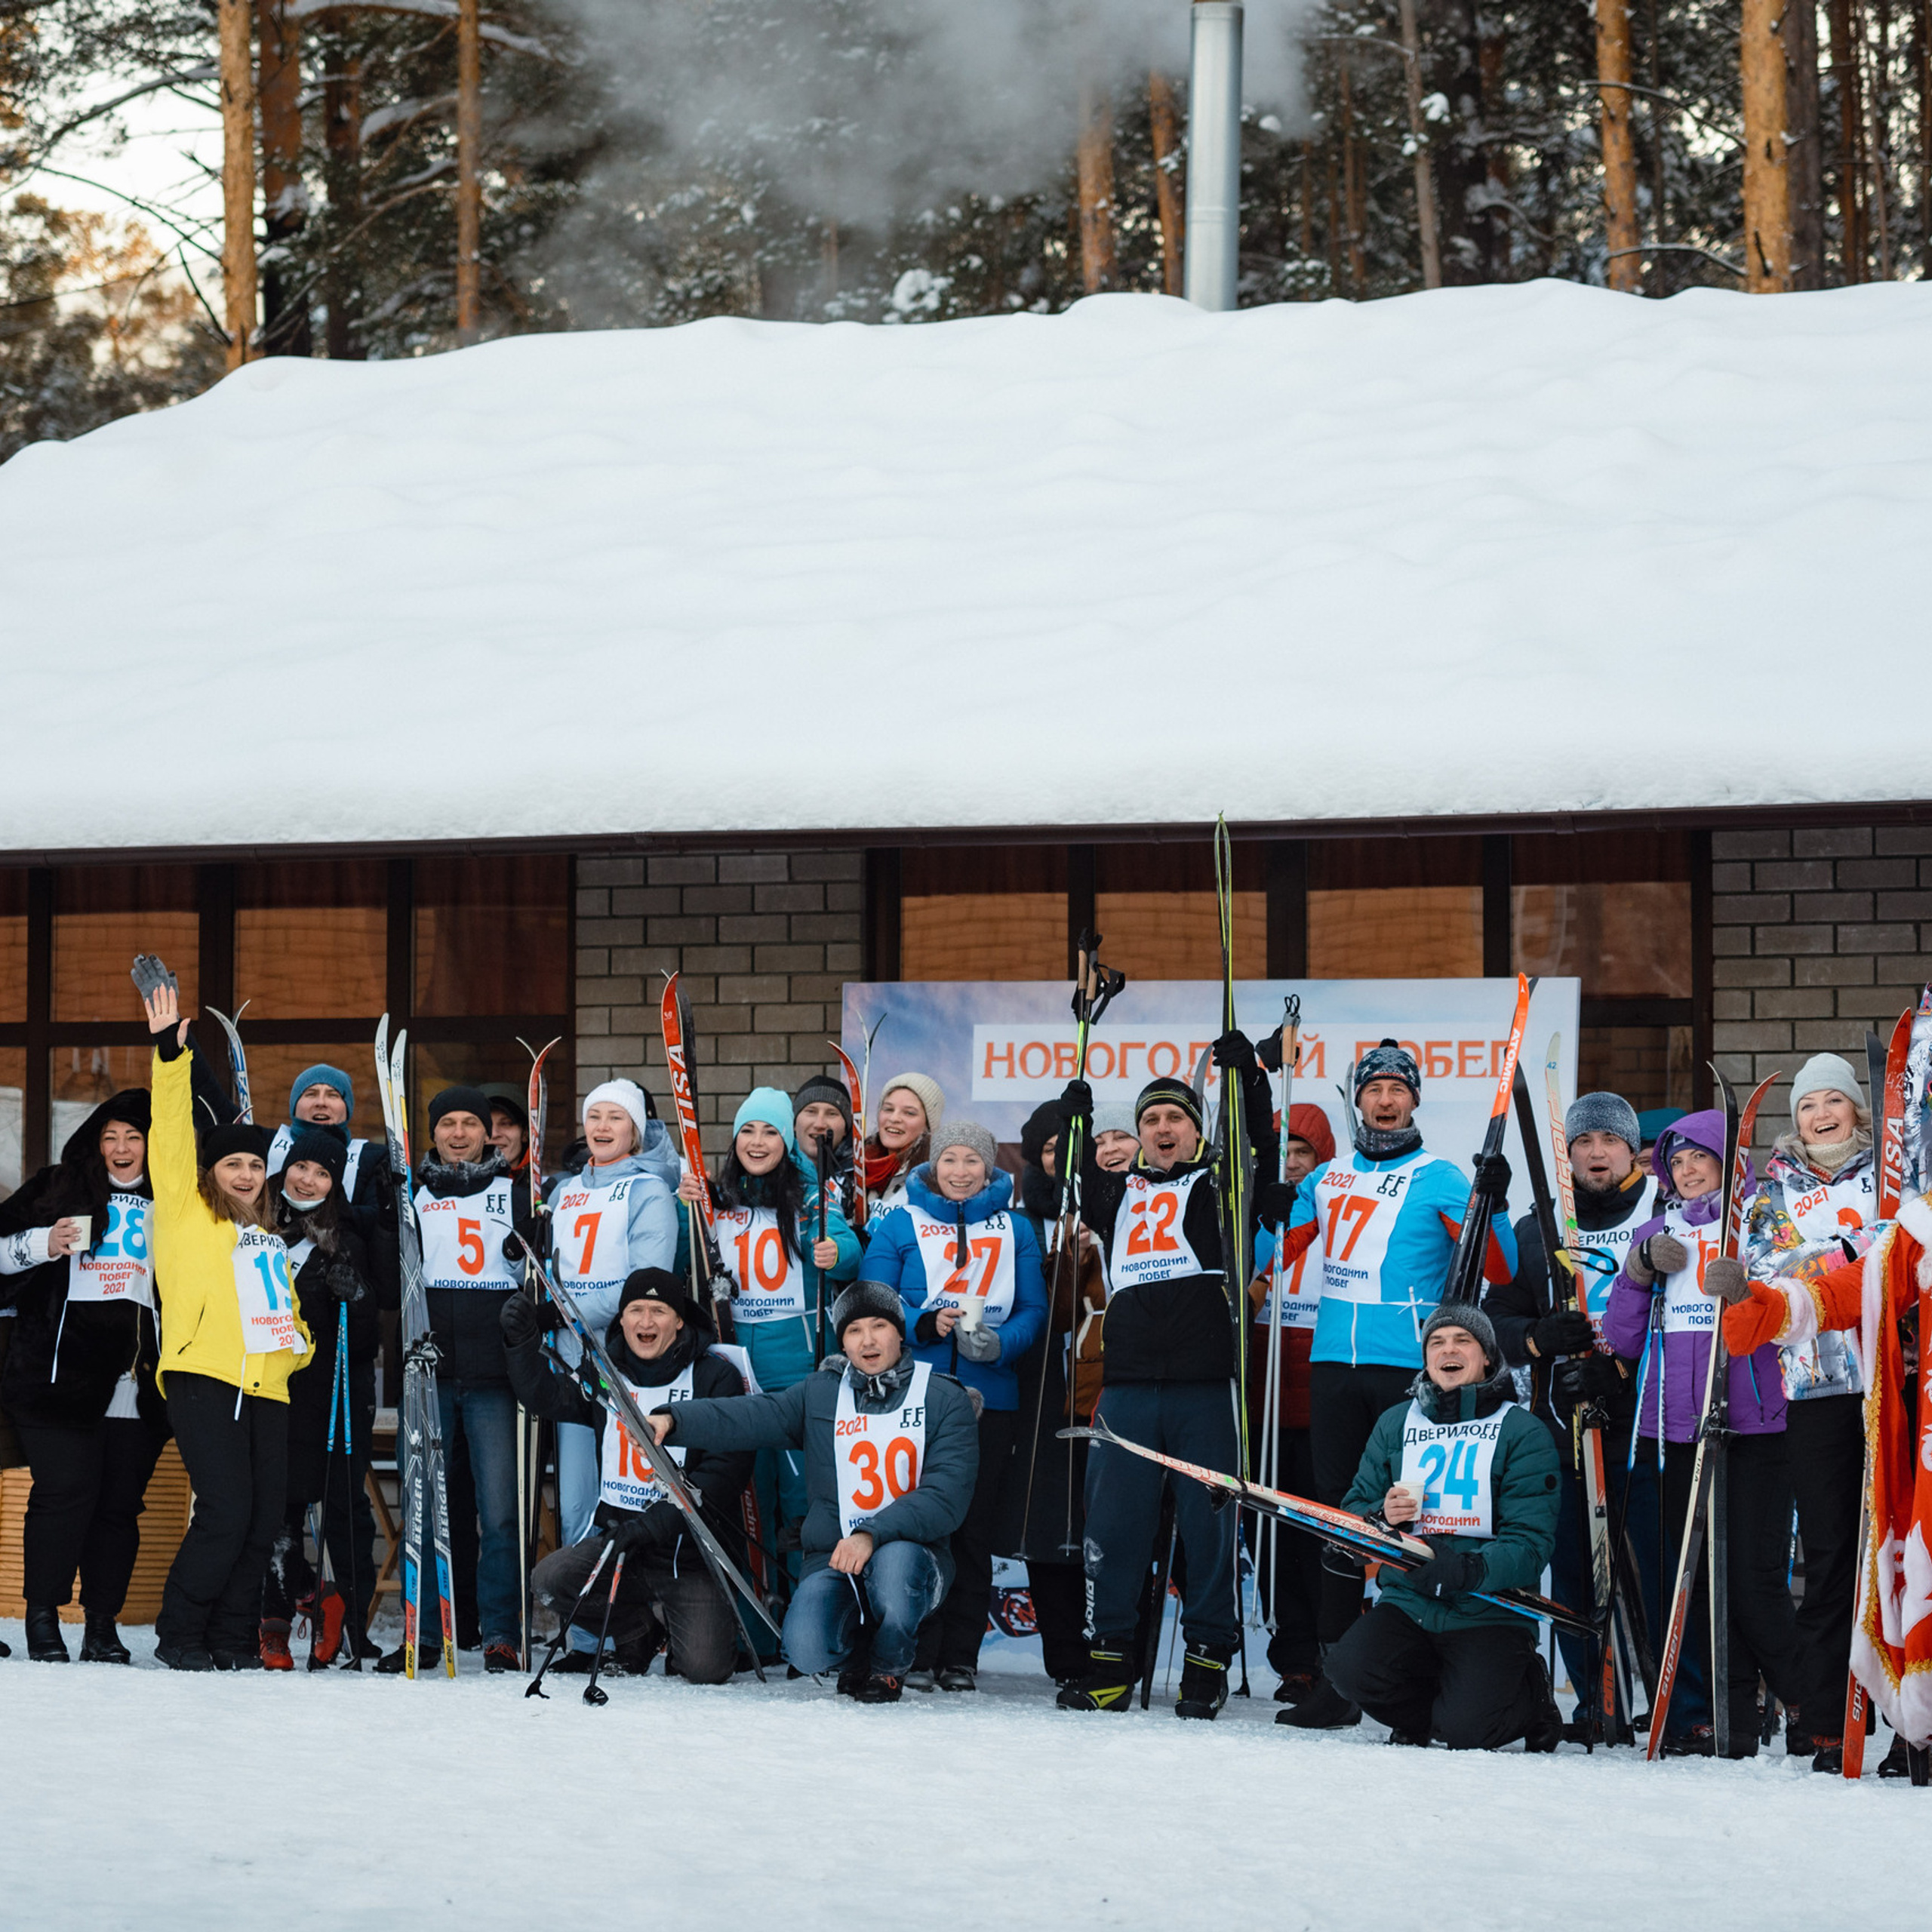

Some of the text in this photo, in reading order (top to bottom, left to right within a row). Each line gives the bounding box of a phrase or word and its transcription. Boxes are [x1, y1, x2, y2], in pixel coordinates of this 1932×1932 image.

[1497, 1027, 1521, 1094] ATOMIC
[1547, 1060, 1557, 1069] 42
[668, 1044, 697, 1134] TISA
[1321, 1171, 1358, 1189] 2021
[1884, 1117, 1905, 1200] TISA
[423, 1200, 456, 1214] 2021
[561, 1193, 590, 1211] 2021
[718, 1209, 749, 1226] 2021
[1727, 1146, 1750, 1245] TISA
[1794, 1186, 1829, 1218] 2021
[89, 1205, 148, 1260] 28
[457, 1217, 485, 1276] 5
[574, 1212, 602, 1275] 7
[920, 1224, 956, 1238] 2021
[1126, 1192, 1180, 1257] 22
[1325, 1193, 1380, 1263] 17
[99, 1272, 133, 1282] ПОБЕГ
[254, 1251, 292, 1311] 19
[734, 1228, 789, 1292] 10
[943, 1237, 1003, 1297] 27
[1138, 1269, 1171, 1283] ПОБЕГ
[103, 1282, 126, 1295] 2021
[1672, 1303, 1716, 1314] НОВОГО
[251, 1314, 293, 1325] НОВОГО
[271, 1324, 294, 1337] ПОБ
[743, 1309, 774, 1318] ПОБЕГ
[836, 1415, 867, 1437] 2021
[848, 1436, 917, 1510] 30
[1418, 1440, 1479, 1511] 24
[437, 1470, 450, 1539] BERGER
[1662, 1625, 1678, 1697] super
[1853, 1679, 1864, 1722] spo
